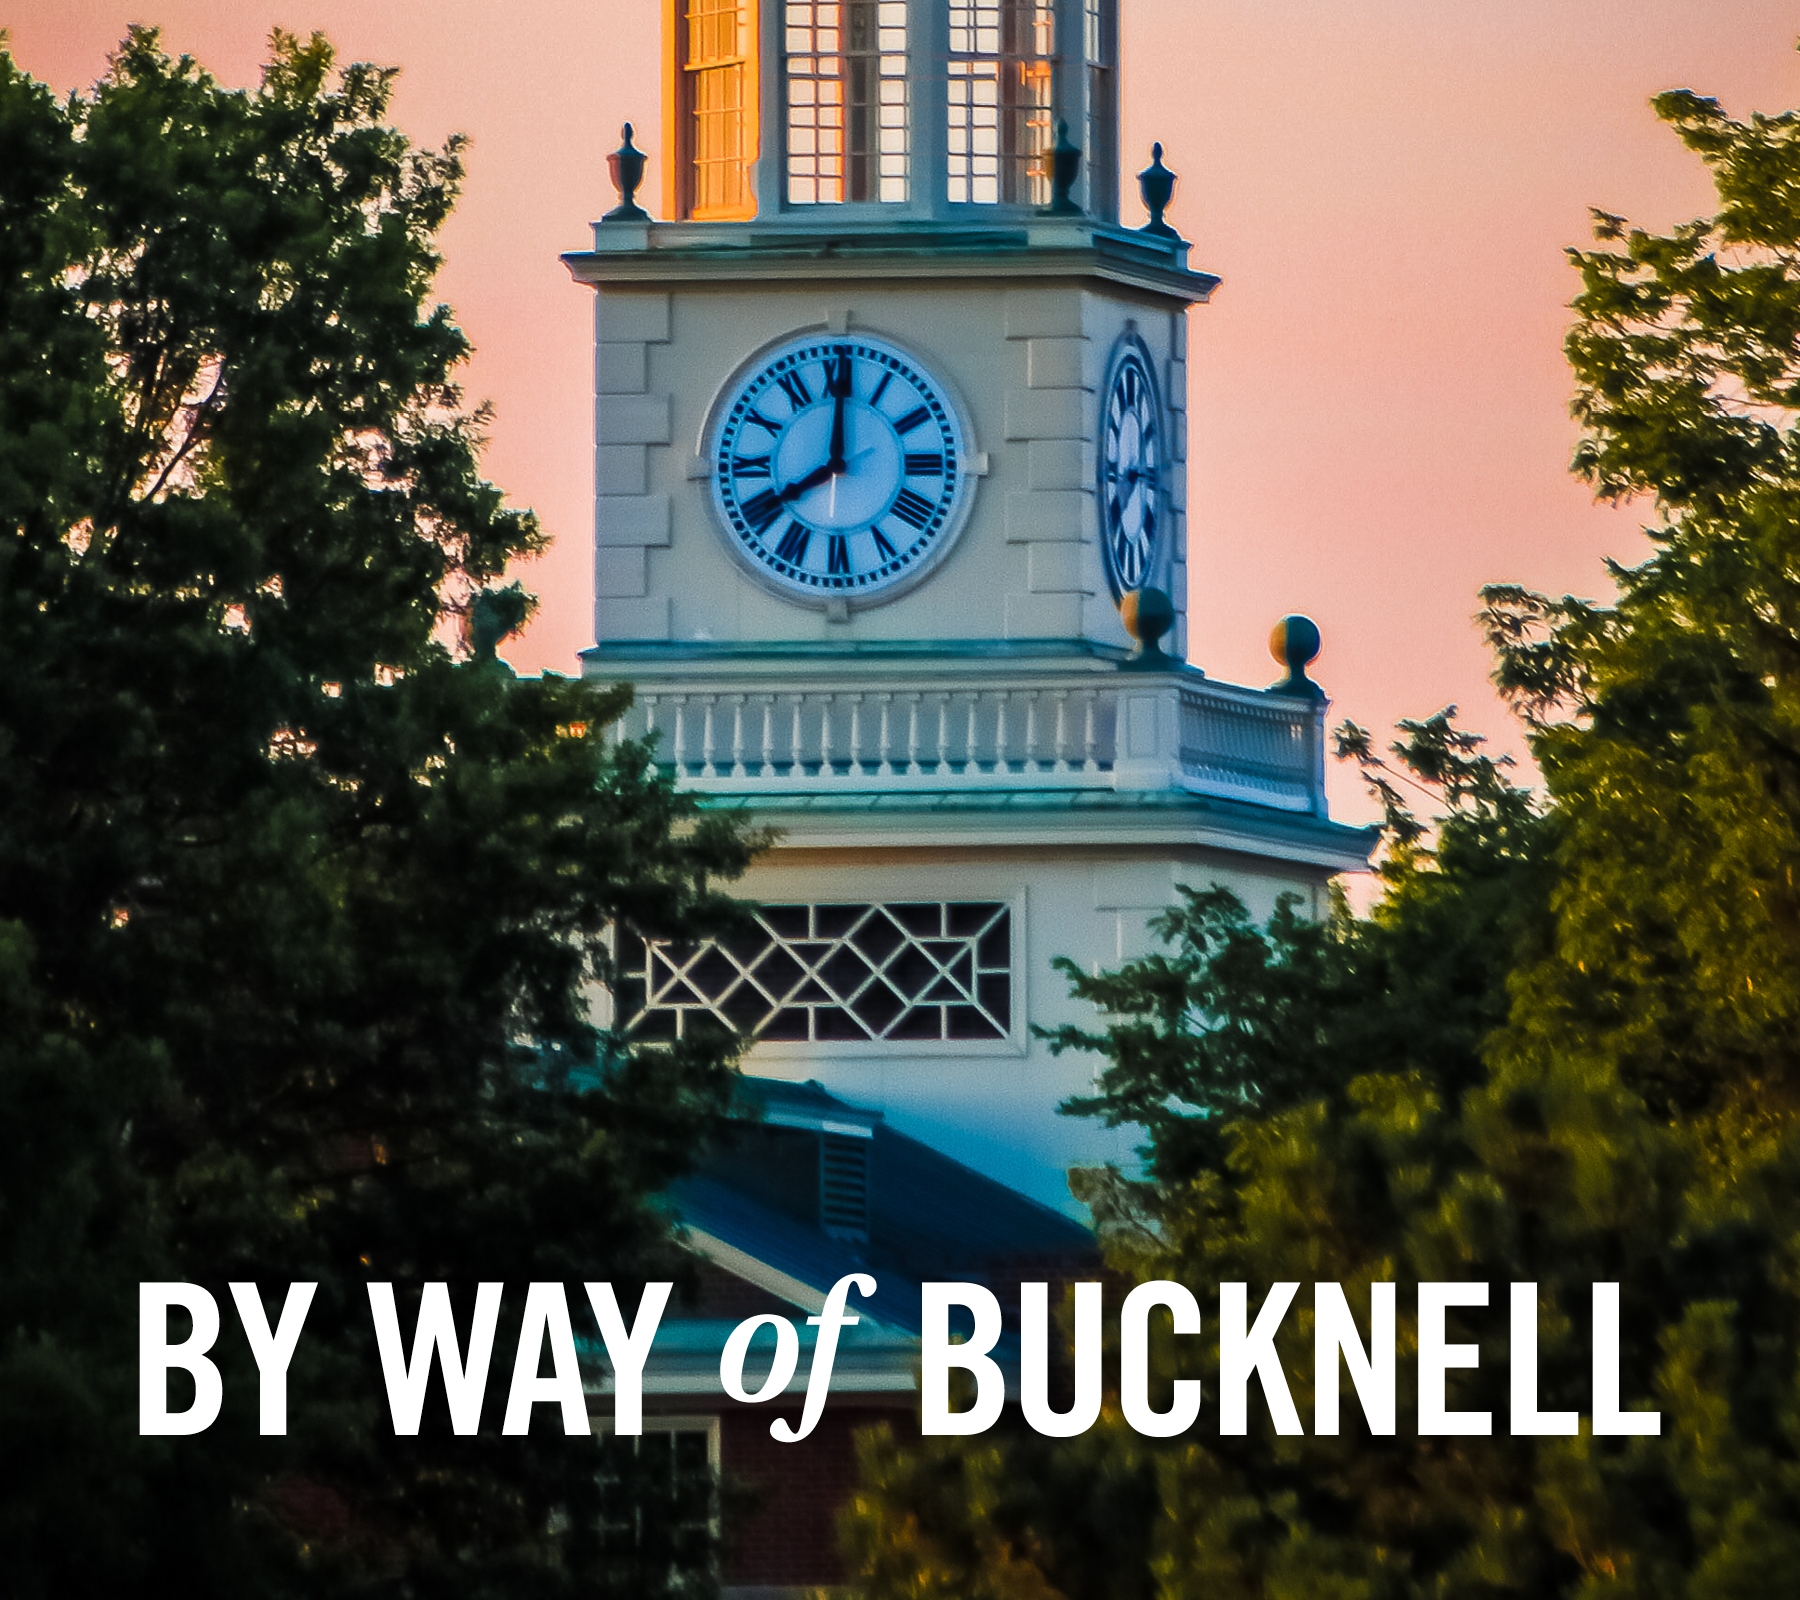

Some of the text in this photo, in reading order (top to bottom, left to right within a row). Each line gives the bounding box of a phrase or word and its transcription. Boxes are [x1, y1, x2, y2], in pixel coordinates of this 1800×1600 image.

[776, 369, 813, 415] XI
[822, 357, 853, 399] XI
[868, 370, 894, 407] I
[743, 406, 783, 439] X
[892, 405, 933, 436] II
[732, 455, 771, 478] IX
[904, 453, 943, 476] III
[740, 487, 785, 537] VIII
[889, 486, 936, 531] IIII
[773, 519, 812, 567] VII
[827, 534, 851, 575] VI
[870, 524, 898, 562] V
